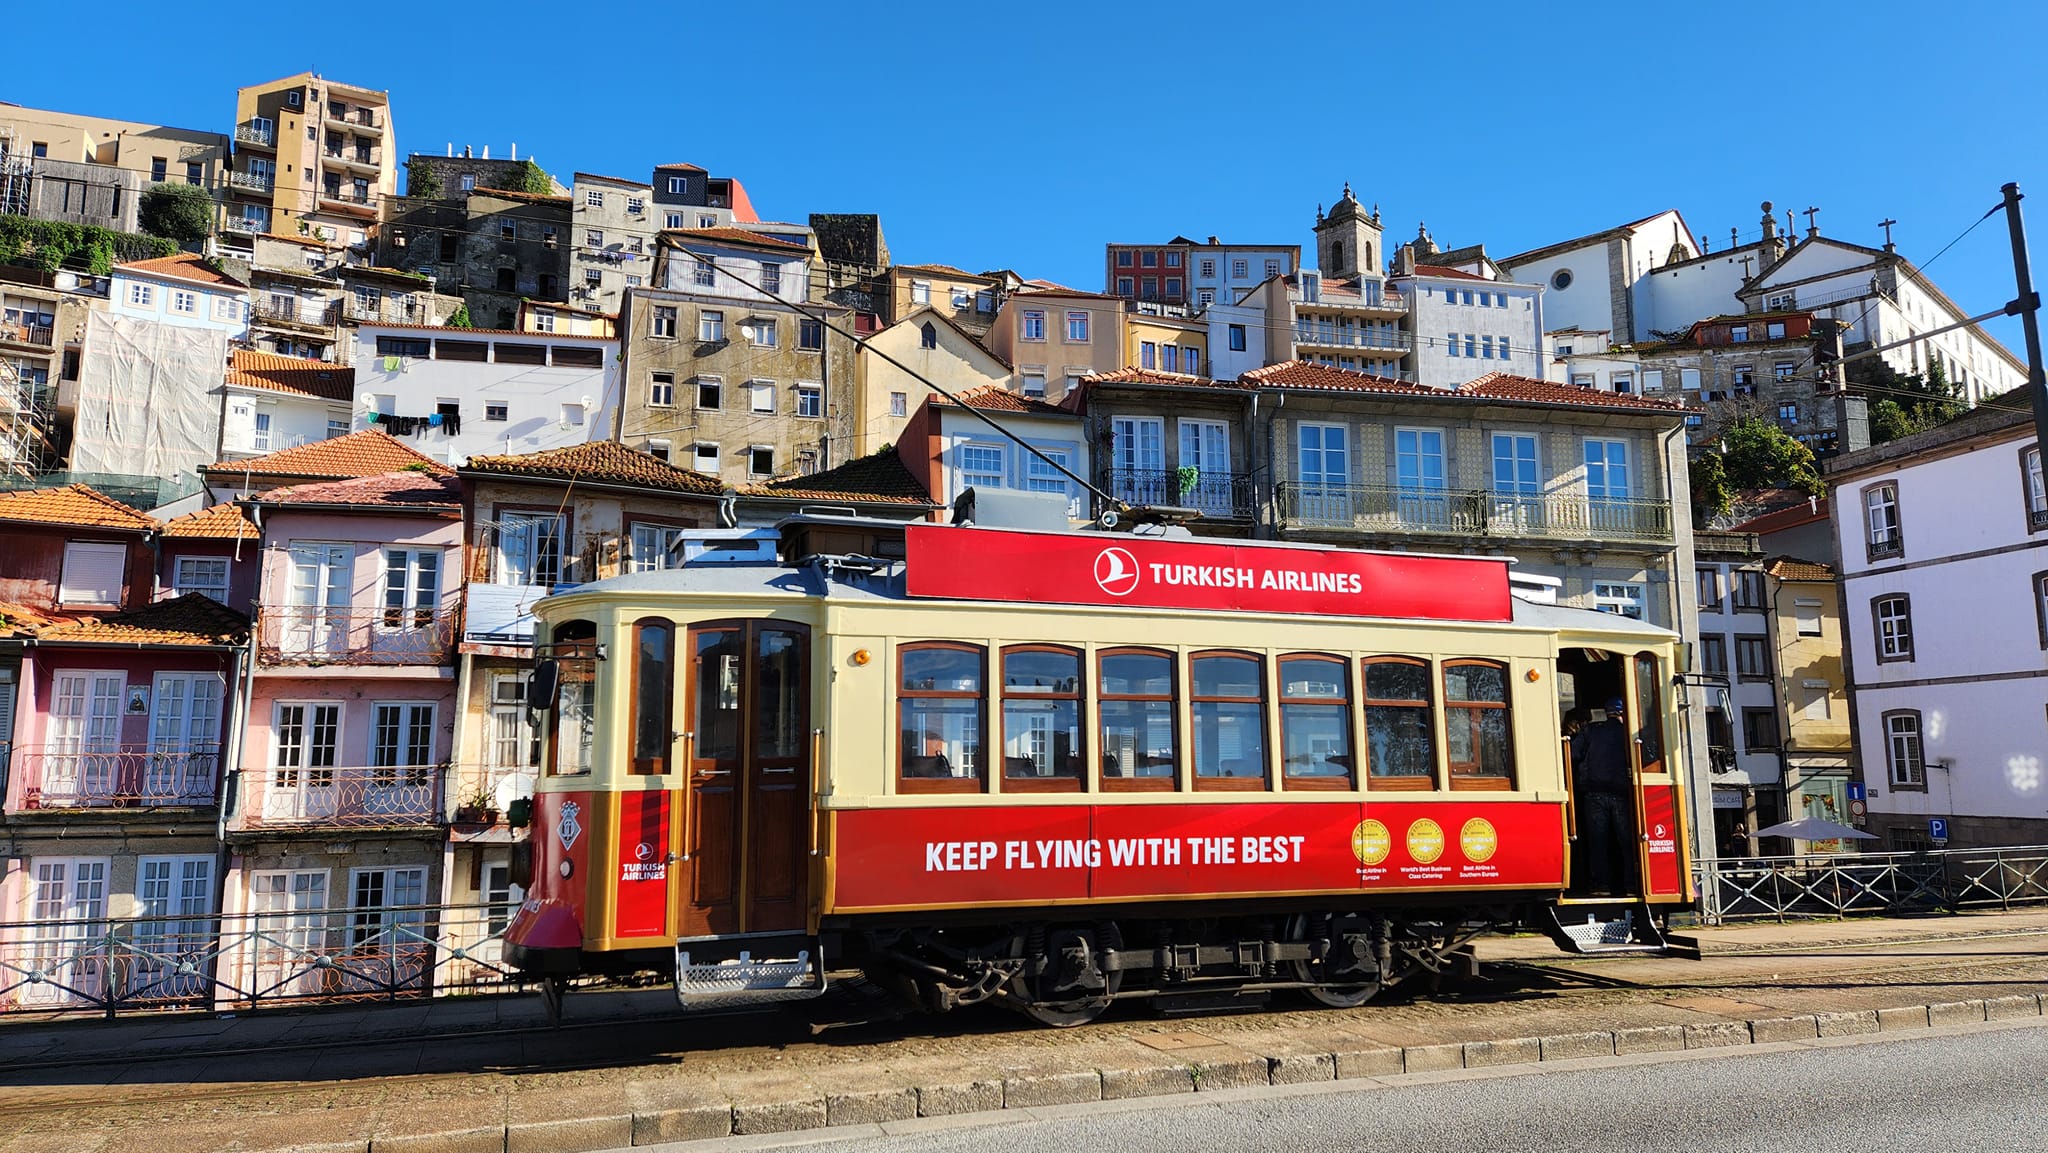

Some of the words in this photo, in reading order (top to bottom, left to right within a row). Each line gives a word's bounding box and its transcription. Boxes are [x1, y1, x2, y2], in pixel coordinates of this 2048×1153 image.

[1149, 563, 1254, 589] TURKISH
[1260, 570, 1362, 594] AIRLINES
[1932, 820, 1942, 836] P
[925, 842, 998, 872] KEEP
[1005, 839, 1101, 870] FLYING
[1107, 838, 1181, 867] WITH
[1187, 837, 1235, 865] THE
[1242, 836, 1305, 864] BEST
[623, 863, 665, 872] TURKISH
[622, 871, 665, 881] AIRLINES
